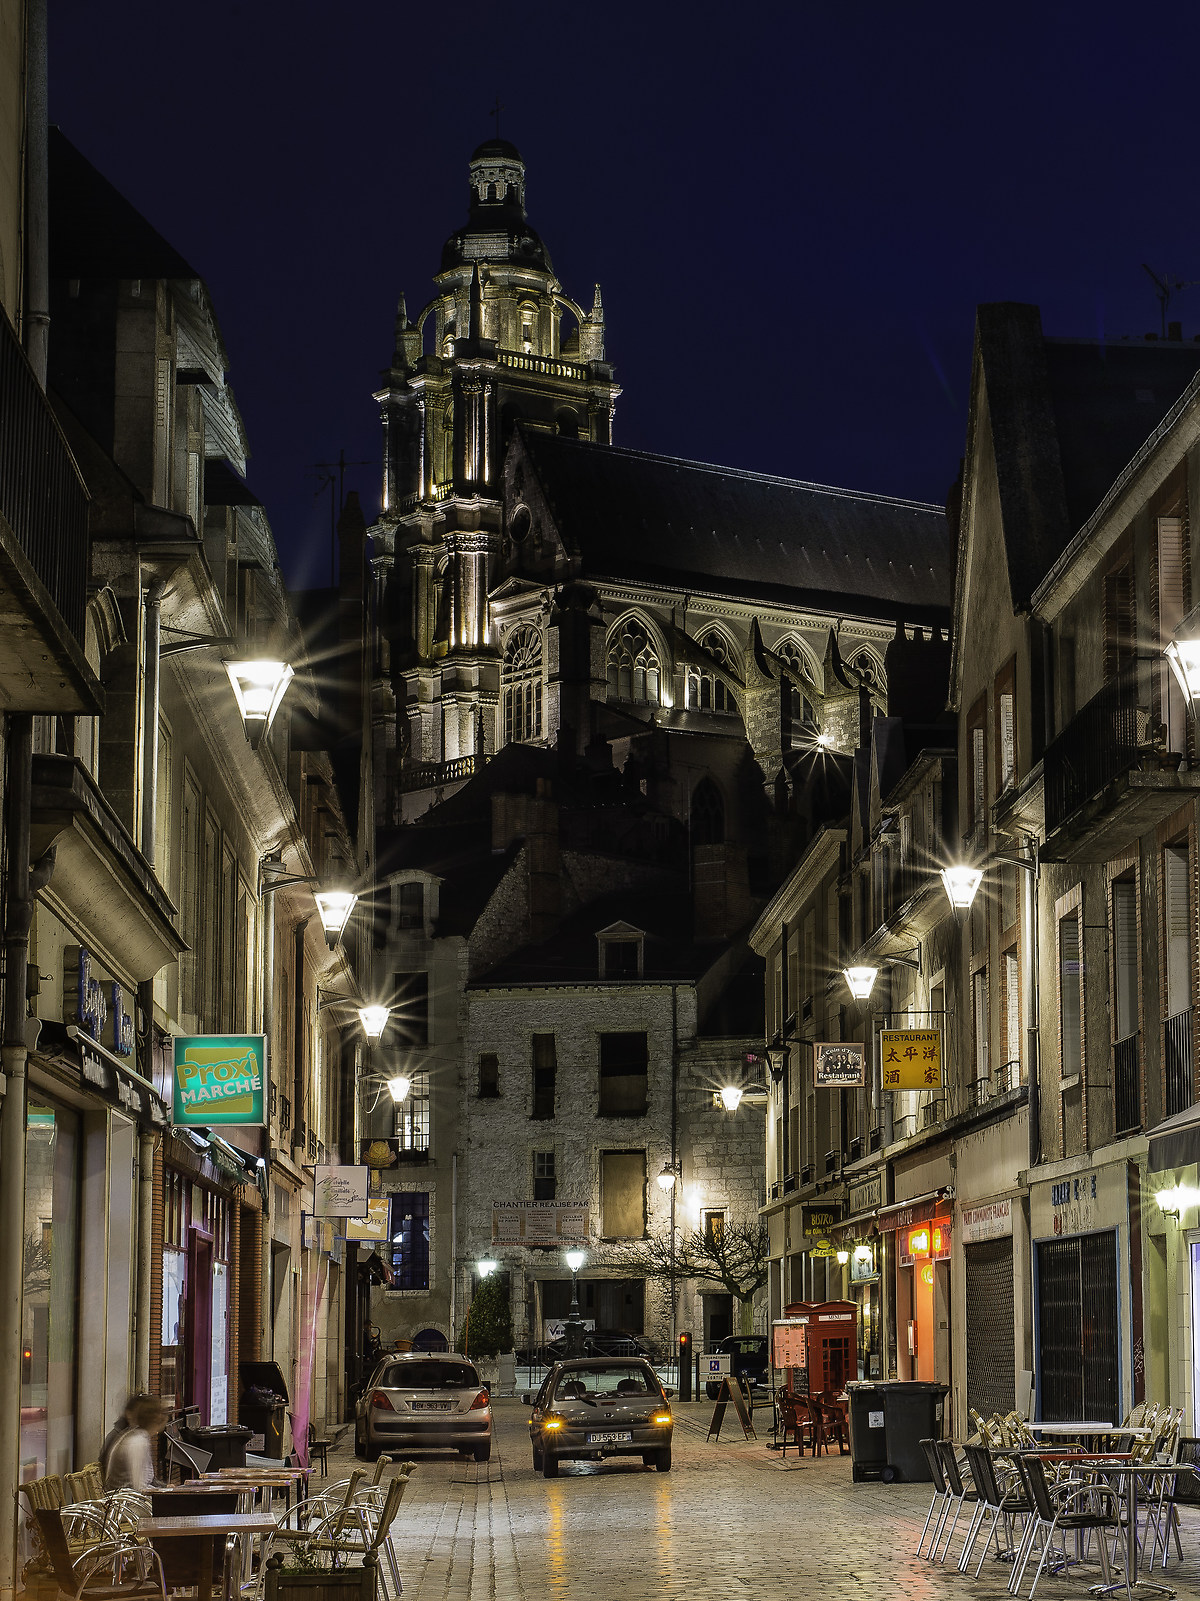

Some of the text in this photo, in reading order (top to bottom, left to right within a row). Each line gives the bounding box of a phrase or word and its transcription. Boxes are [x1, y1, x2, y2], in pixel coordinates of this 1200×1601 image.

[883, 1034, 939, 1042] RESTAURANT
[885, 1046, 939, 1063] 太平洋
[176, 1052, 259, 1089] Proxi
[818, 1072, 861, 1080] Restaurant
[180, 1075, 262, 1104] MARCHÉ
[811, 1214, 834, 1226] BISTRO
